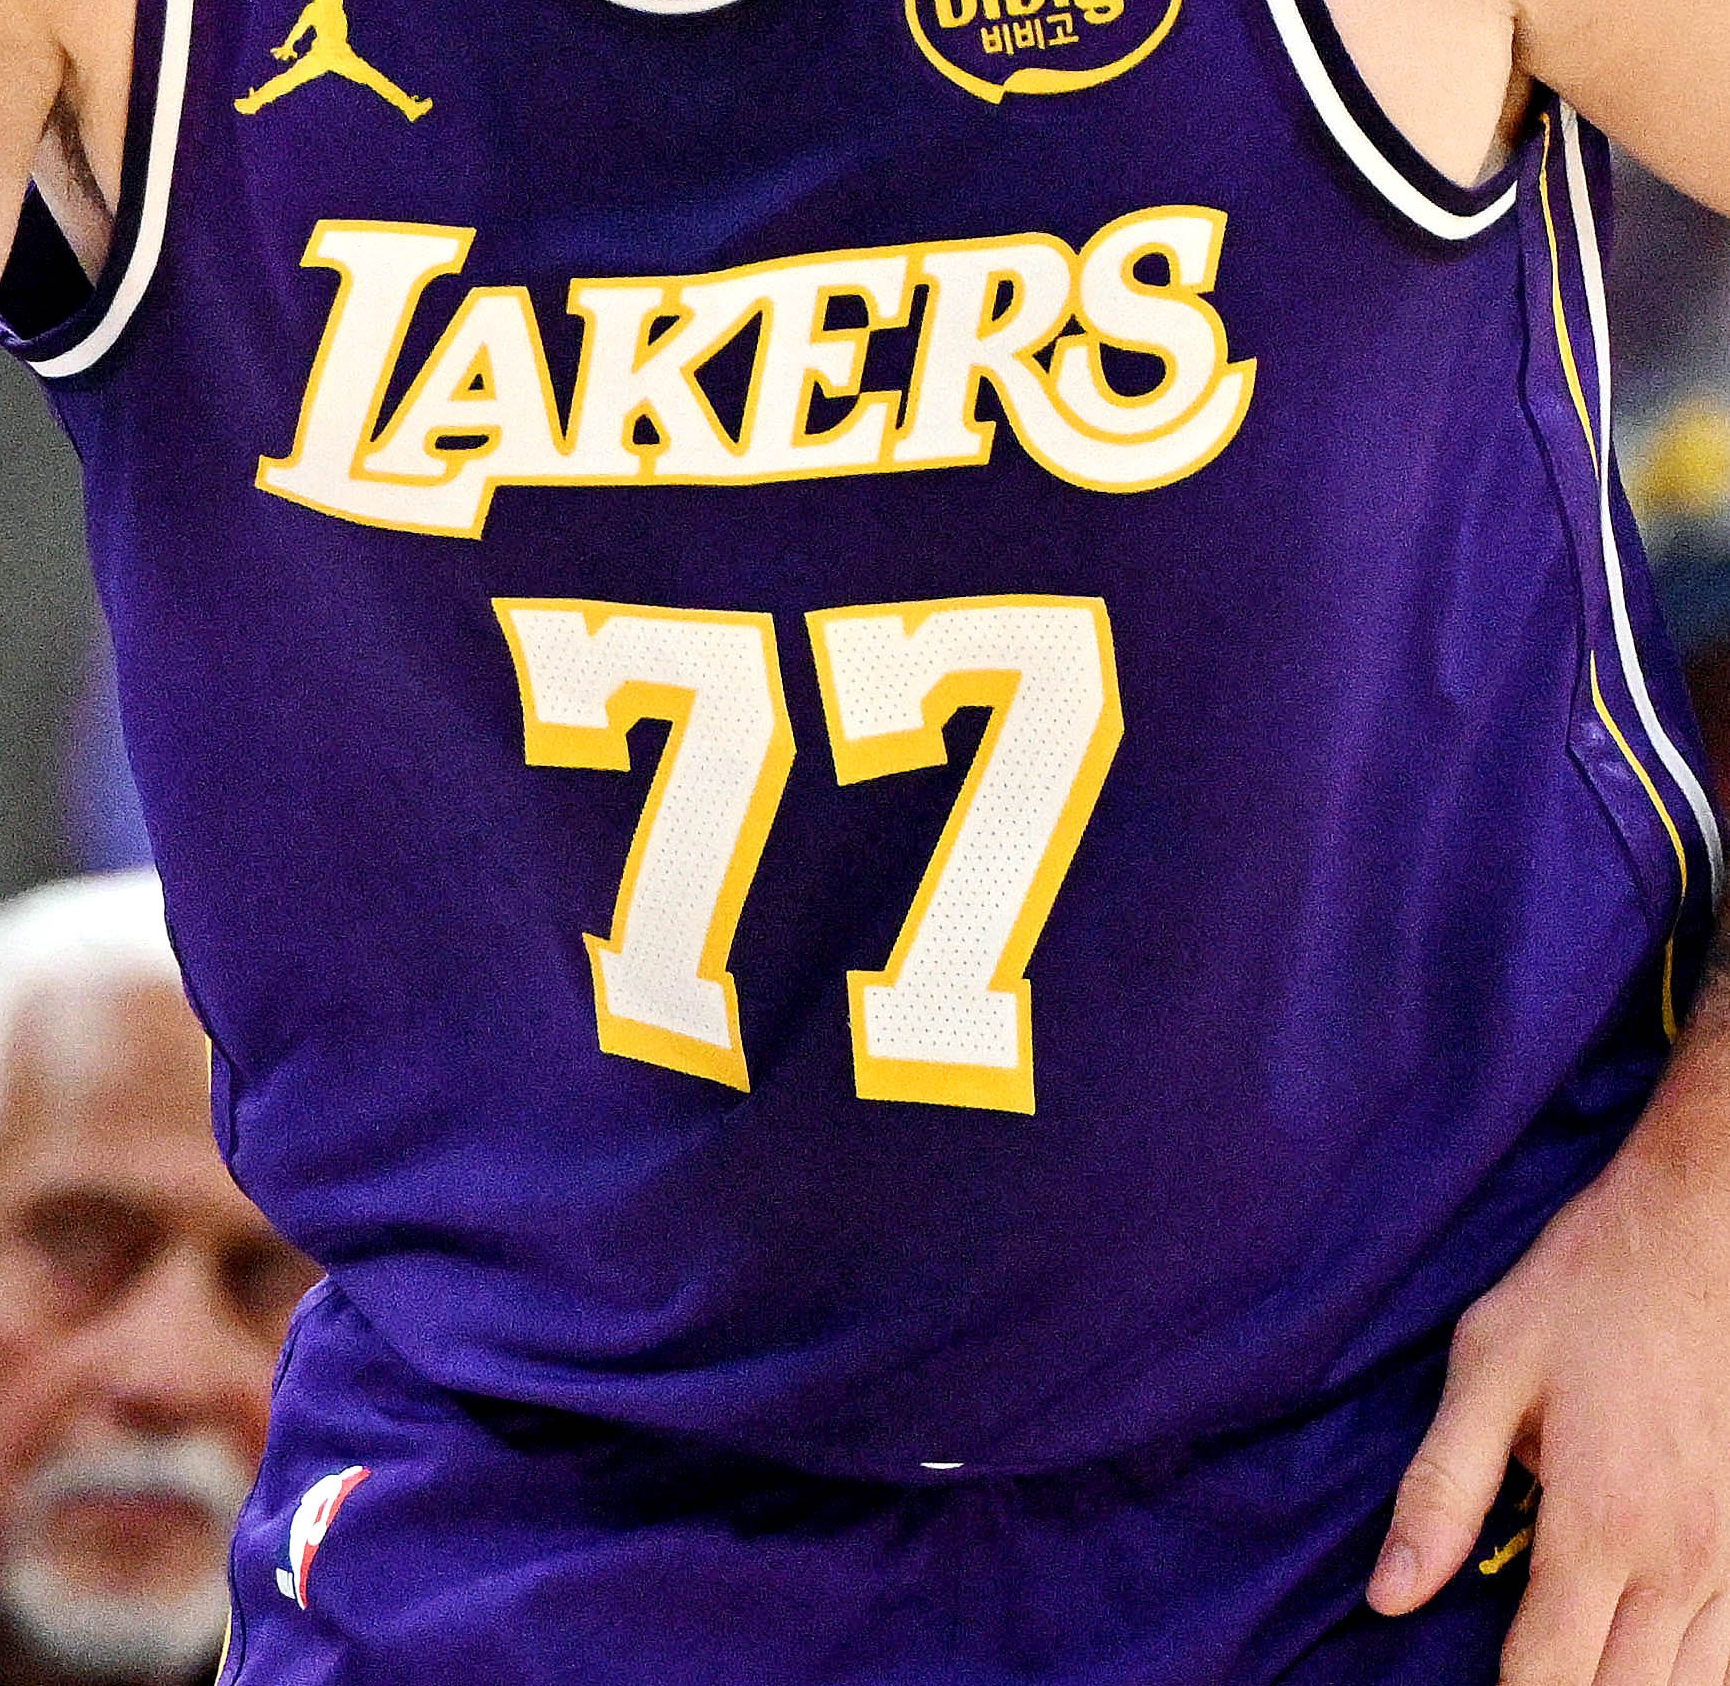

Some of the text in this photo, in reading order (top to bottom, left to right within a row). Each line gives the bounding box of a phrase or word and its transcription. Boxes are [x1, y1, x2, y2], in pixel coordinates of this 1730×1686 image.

[980, 12, 1080, 56] 비비고
[254, 204, 1258, 541] LAKERS
[490, 593, 1125, 1116] 77
